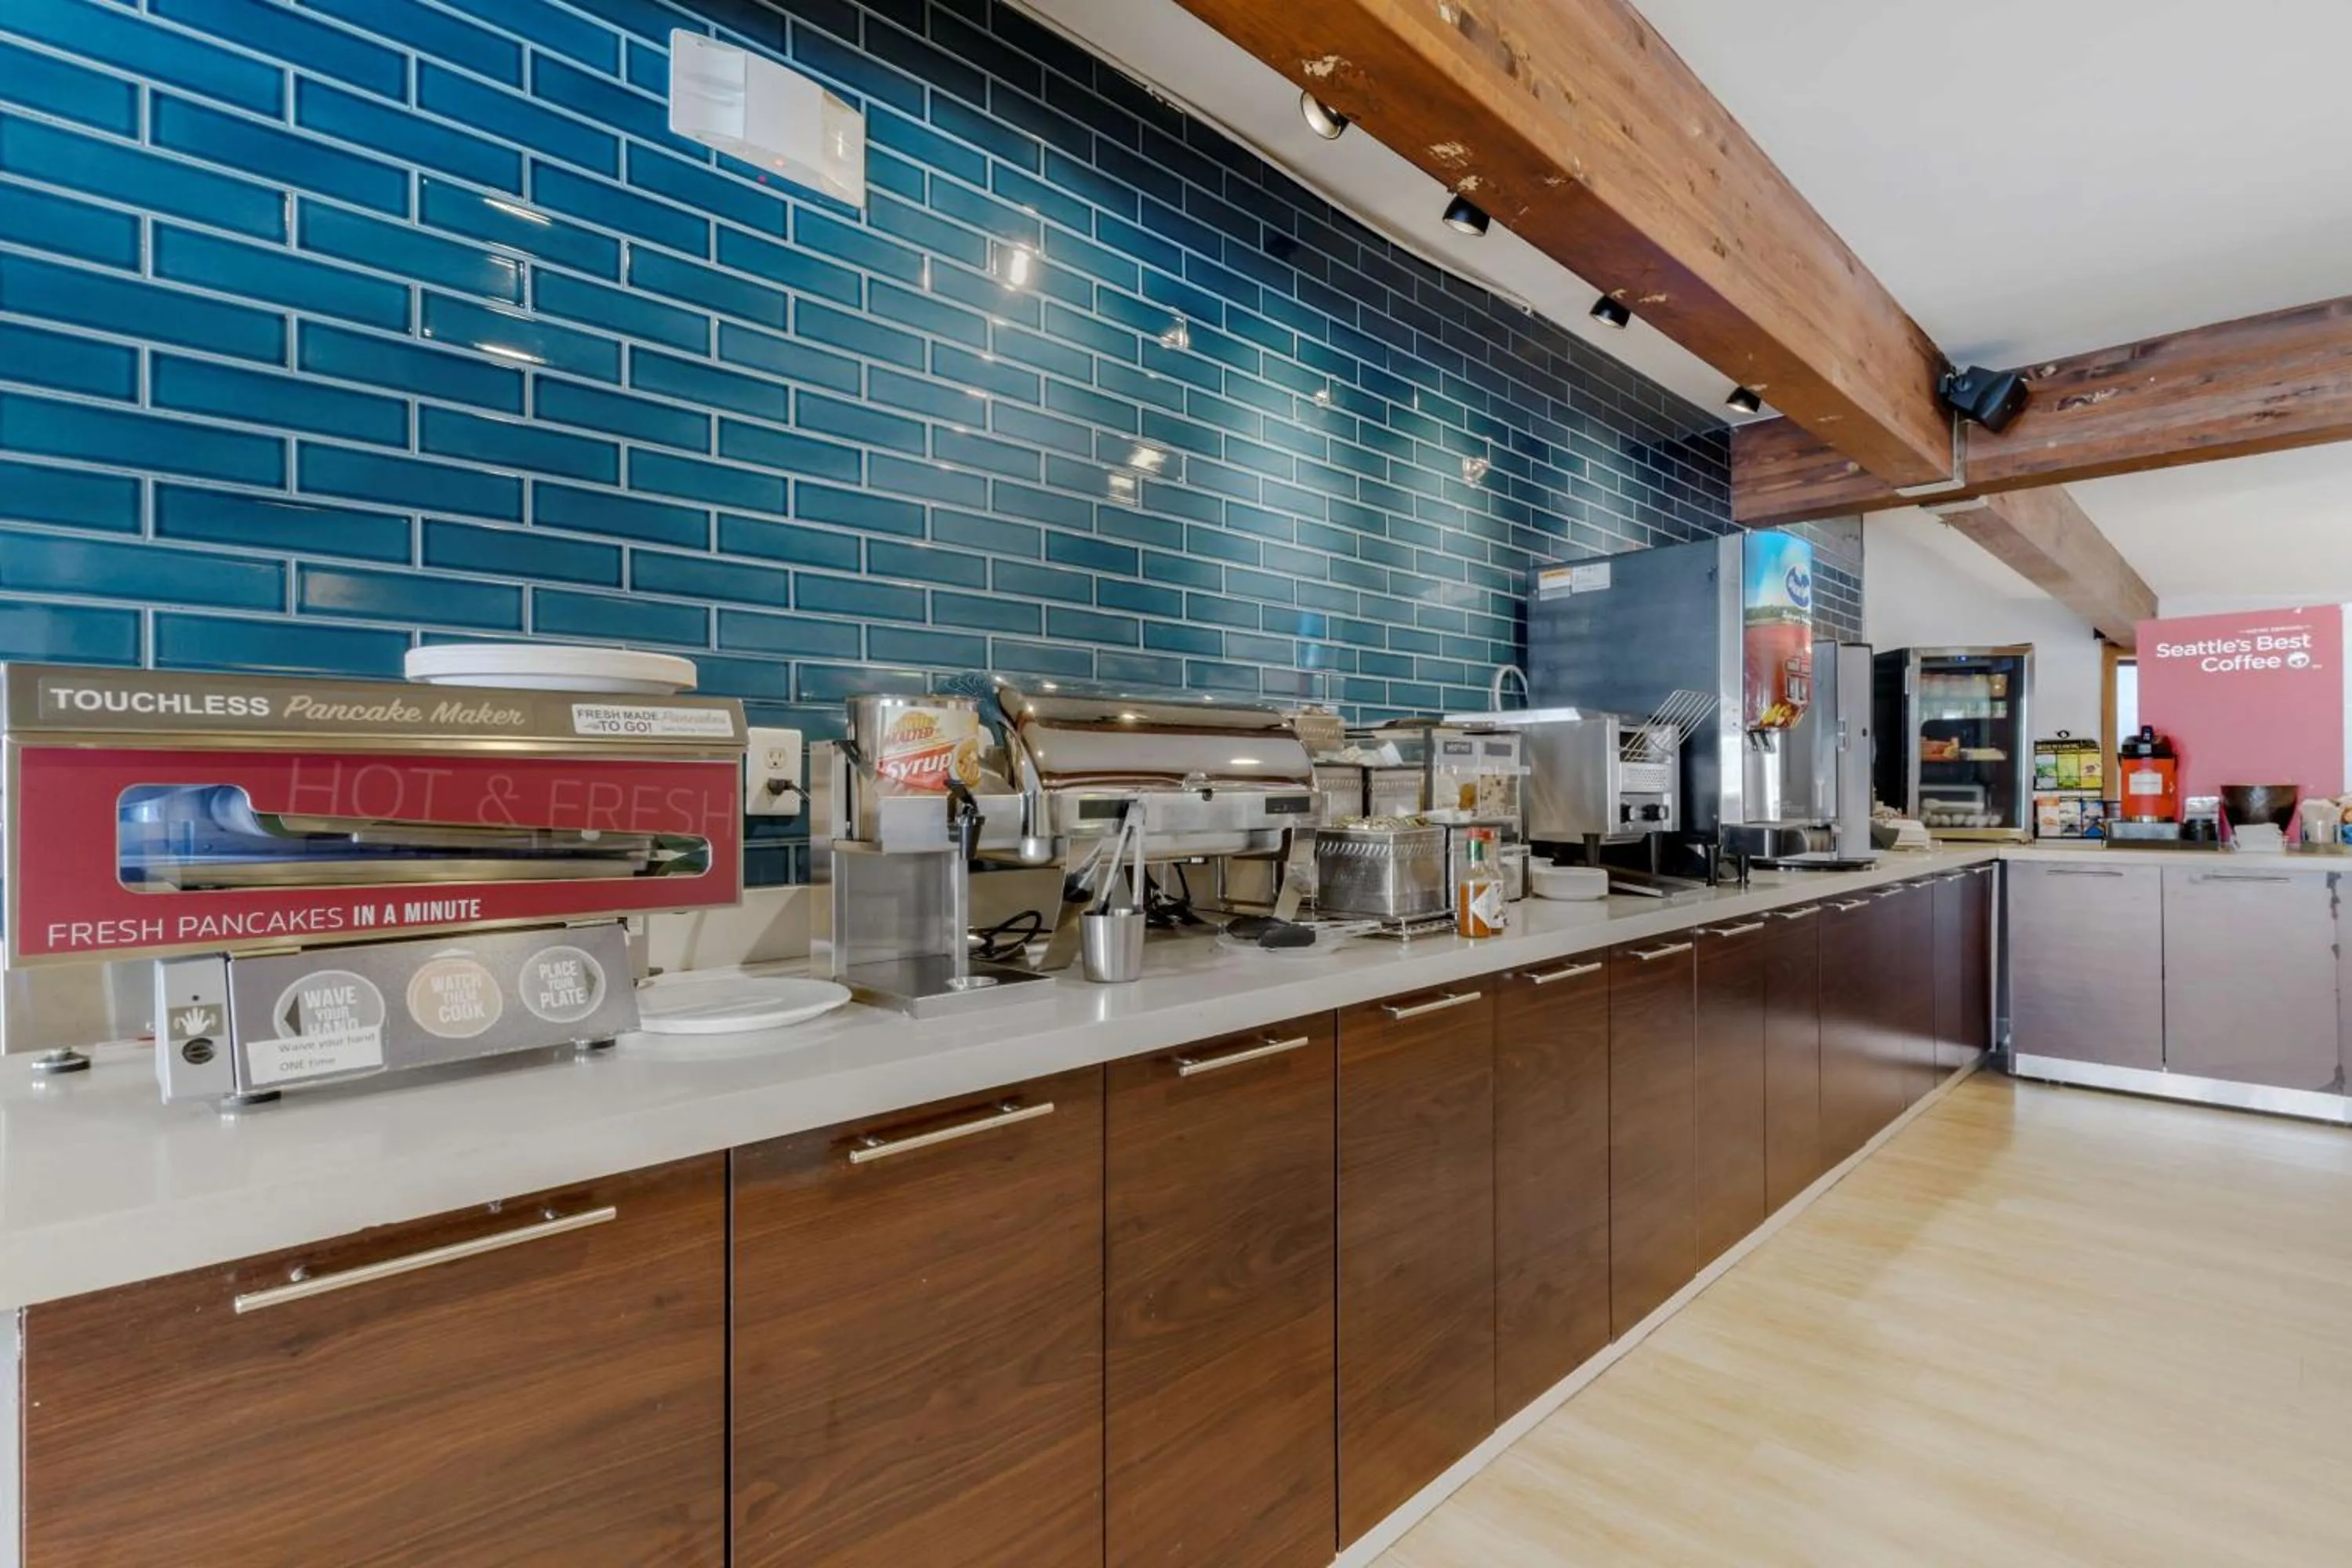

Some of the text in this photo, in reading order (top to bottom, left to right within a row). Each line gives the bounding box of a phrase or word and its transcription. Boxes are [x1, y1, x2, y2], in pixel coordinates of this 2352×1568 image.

[2157, 633, 2312, 658] Seattle's Best
[2201, 654, 2281, 672] Coffee
[49, 688, 525, 725] TOUCHLESS Pancake Maker
[577, 709, 659, 720] FRESH MADE
[600, 720, 620, 732] TO
[624, 721, 652, 733] GO!
[286, 757, 735, 839] HOT & FRESH
[49, 898, 481, 947] FRESH PANCAKES IN A MINUTE
[539, 960, 578, 979] PLACE
[431, 973, 481, 993] WATCH
[304, 986, 357, 1008] WAVE
[540, 989, 586, 1009] PLATE
[314, 1006, 350, 1021] YOUR
[438, 1000, 485, 1024] COOK
[280, 1059, 304, 1072] ONE
